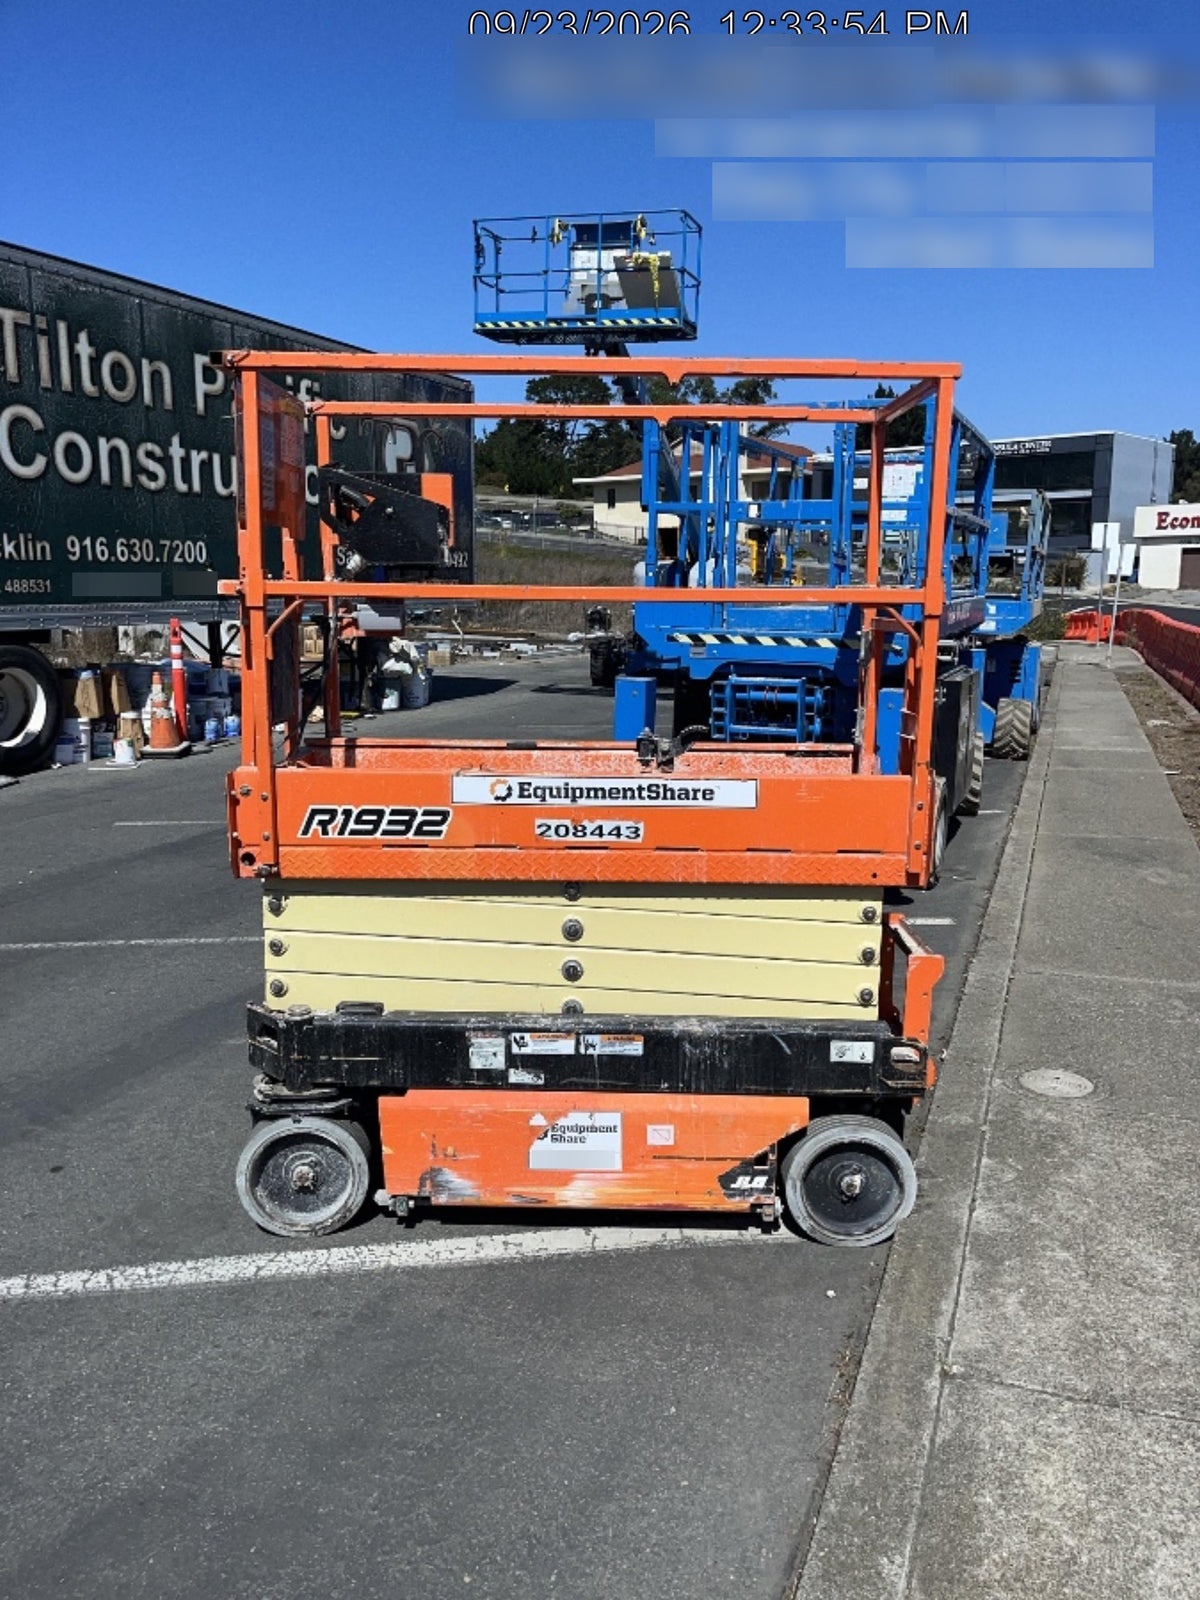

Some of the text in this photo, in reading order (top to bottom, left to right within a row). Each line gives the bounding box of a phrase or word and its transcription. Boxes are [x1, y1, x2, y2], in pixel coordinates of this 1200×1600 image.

[0, 307, 173, 410] Tilton
[0, 533, 207, 563] klin 916.630.7200
[4, 579, 51, 593] 488531
[517, 781, 716, 803] EquipmentShare
[298, 807, 452, 838] R1932
[536, 821, 642, 841] 208443
[550, 1122, 619, 1136] Equipment
[550, 1134, 588, 1144] Share
